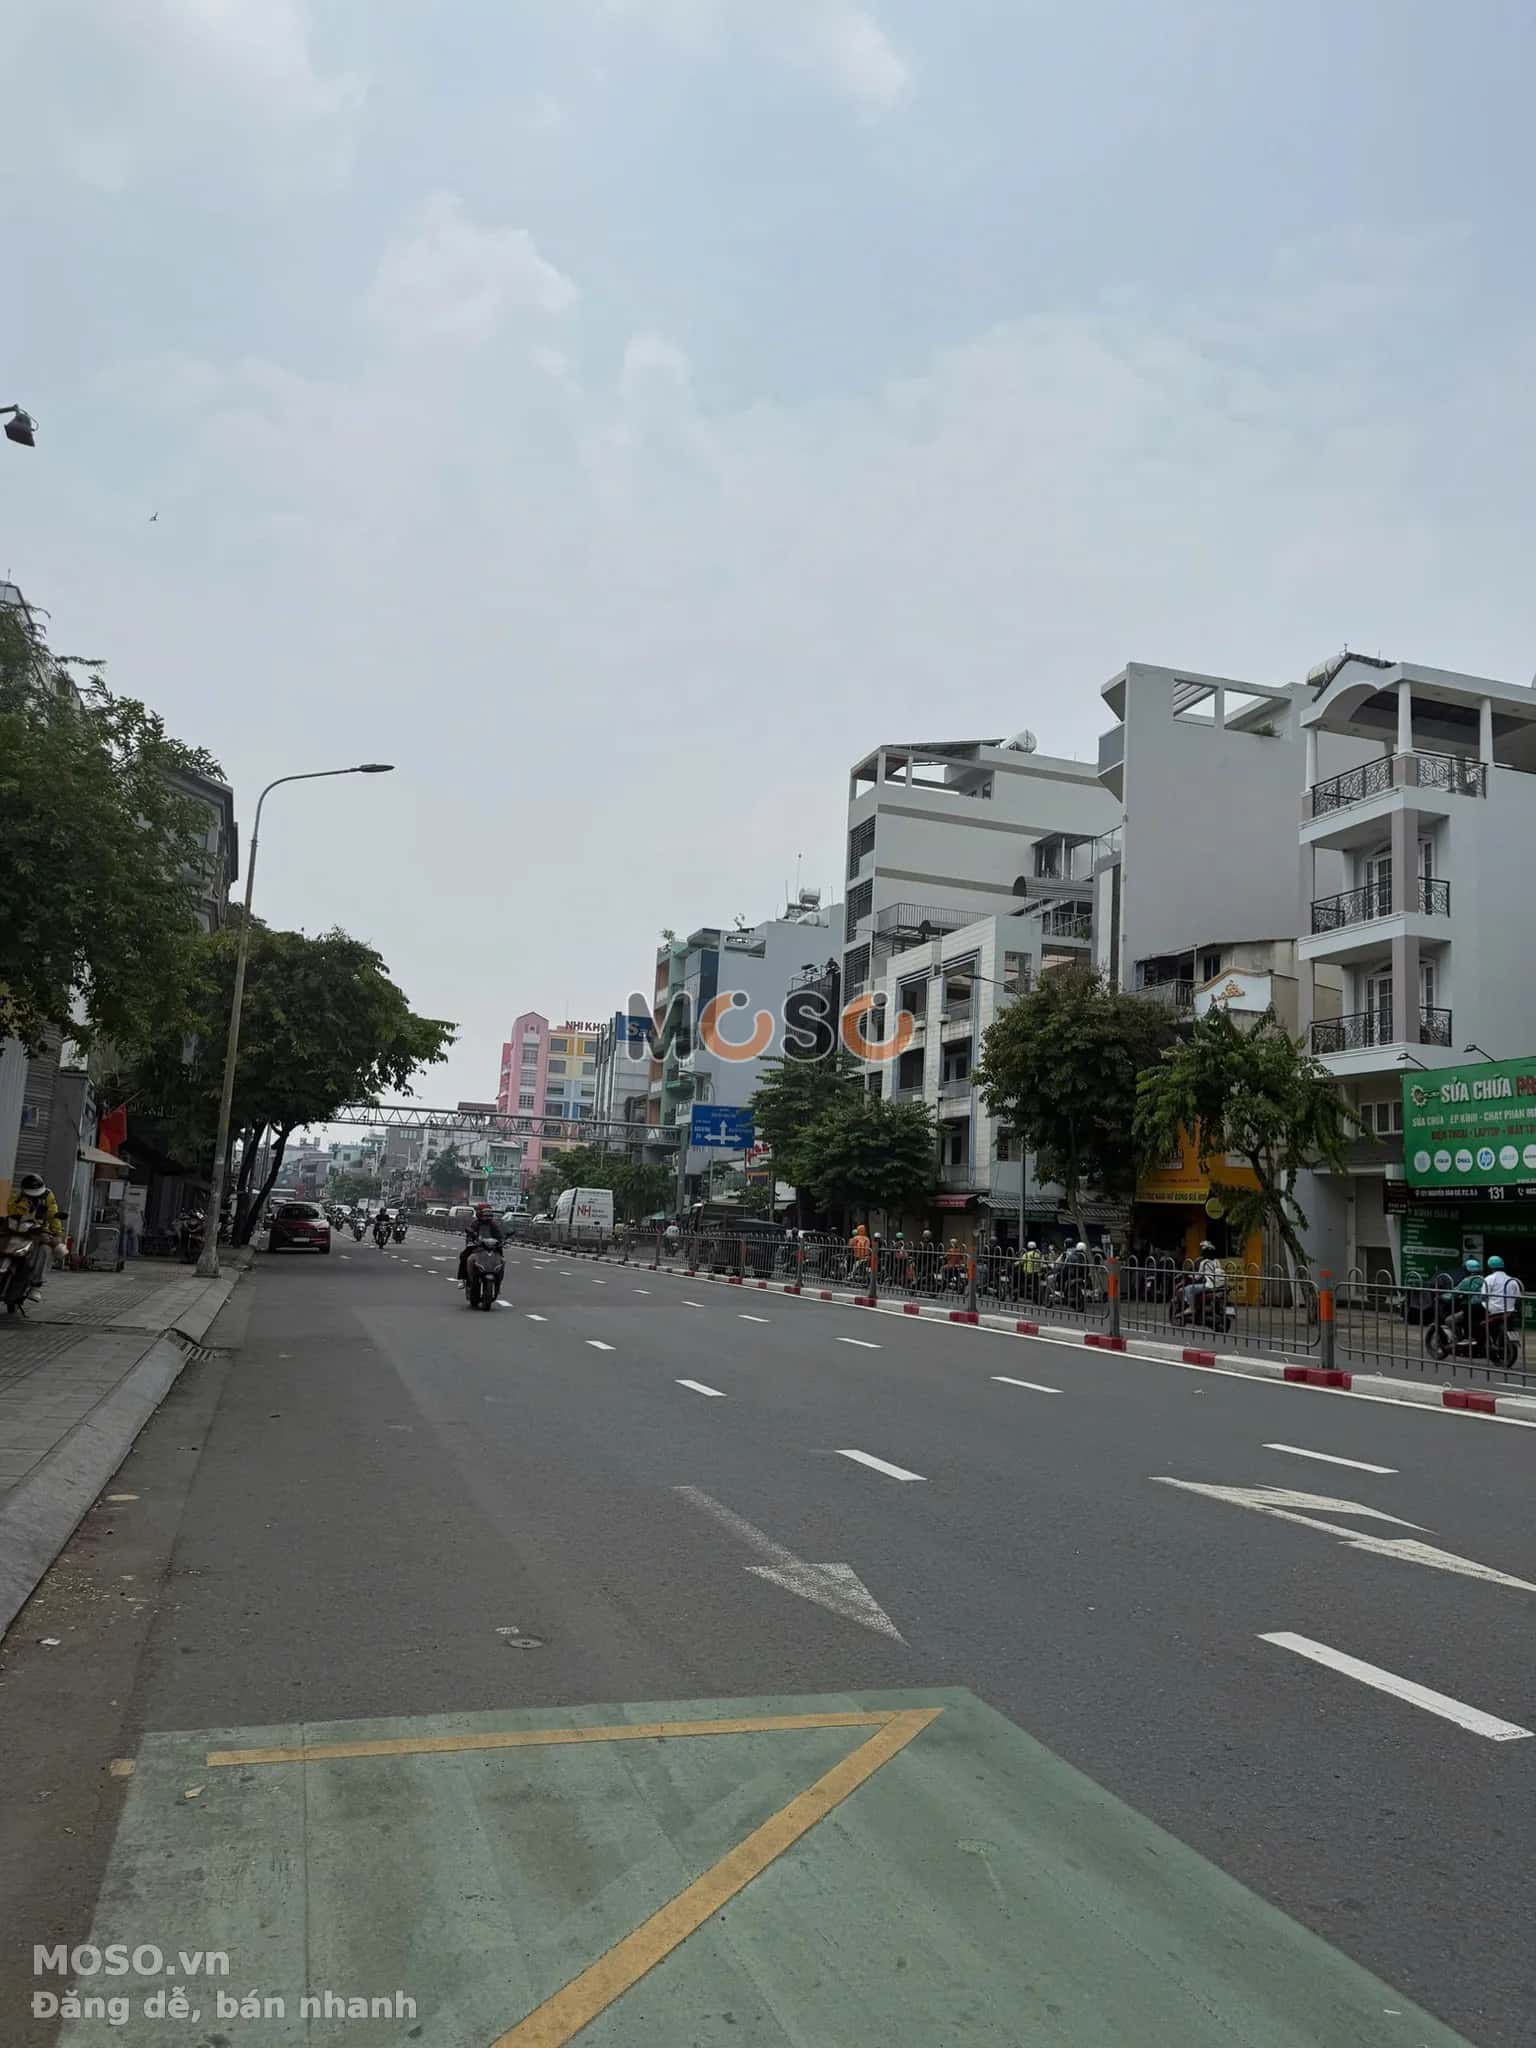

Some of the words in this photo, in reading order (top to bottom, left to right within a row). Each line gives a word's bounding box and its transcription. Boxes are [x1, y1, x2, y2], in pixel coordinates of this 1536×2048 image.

[566, 1020, 584, 1031] NHI
[1441, 1076, 1469, 1104] SỬA
[1472, 1073, 1512, 1101] CHỮA
[1488, 1186, 1505, 1200] 131
